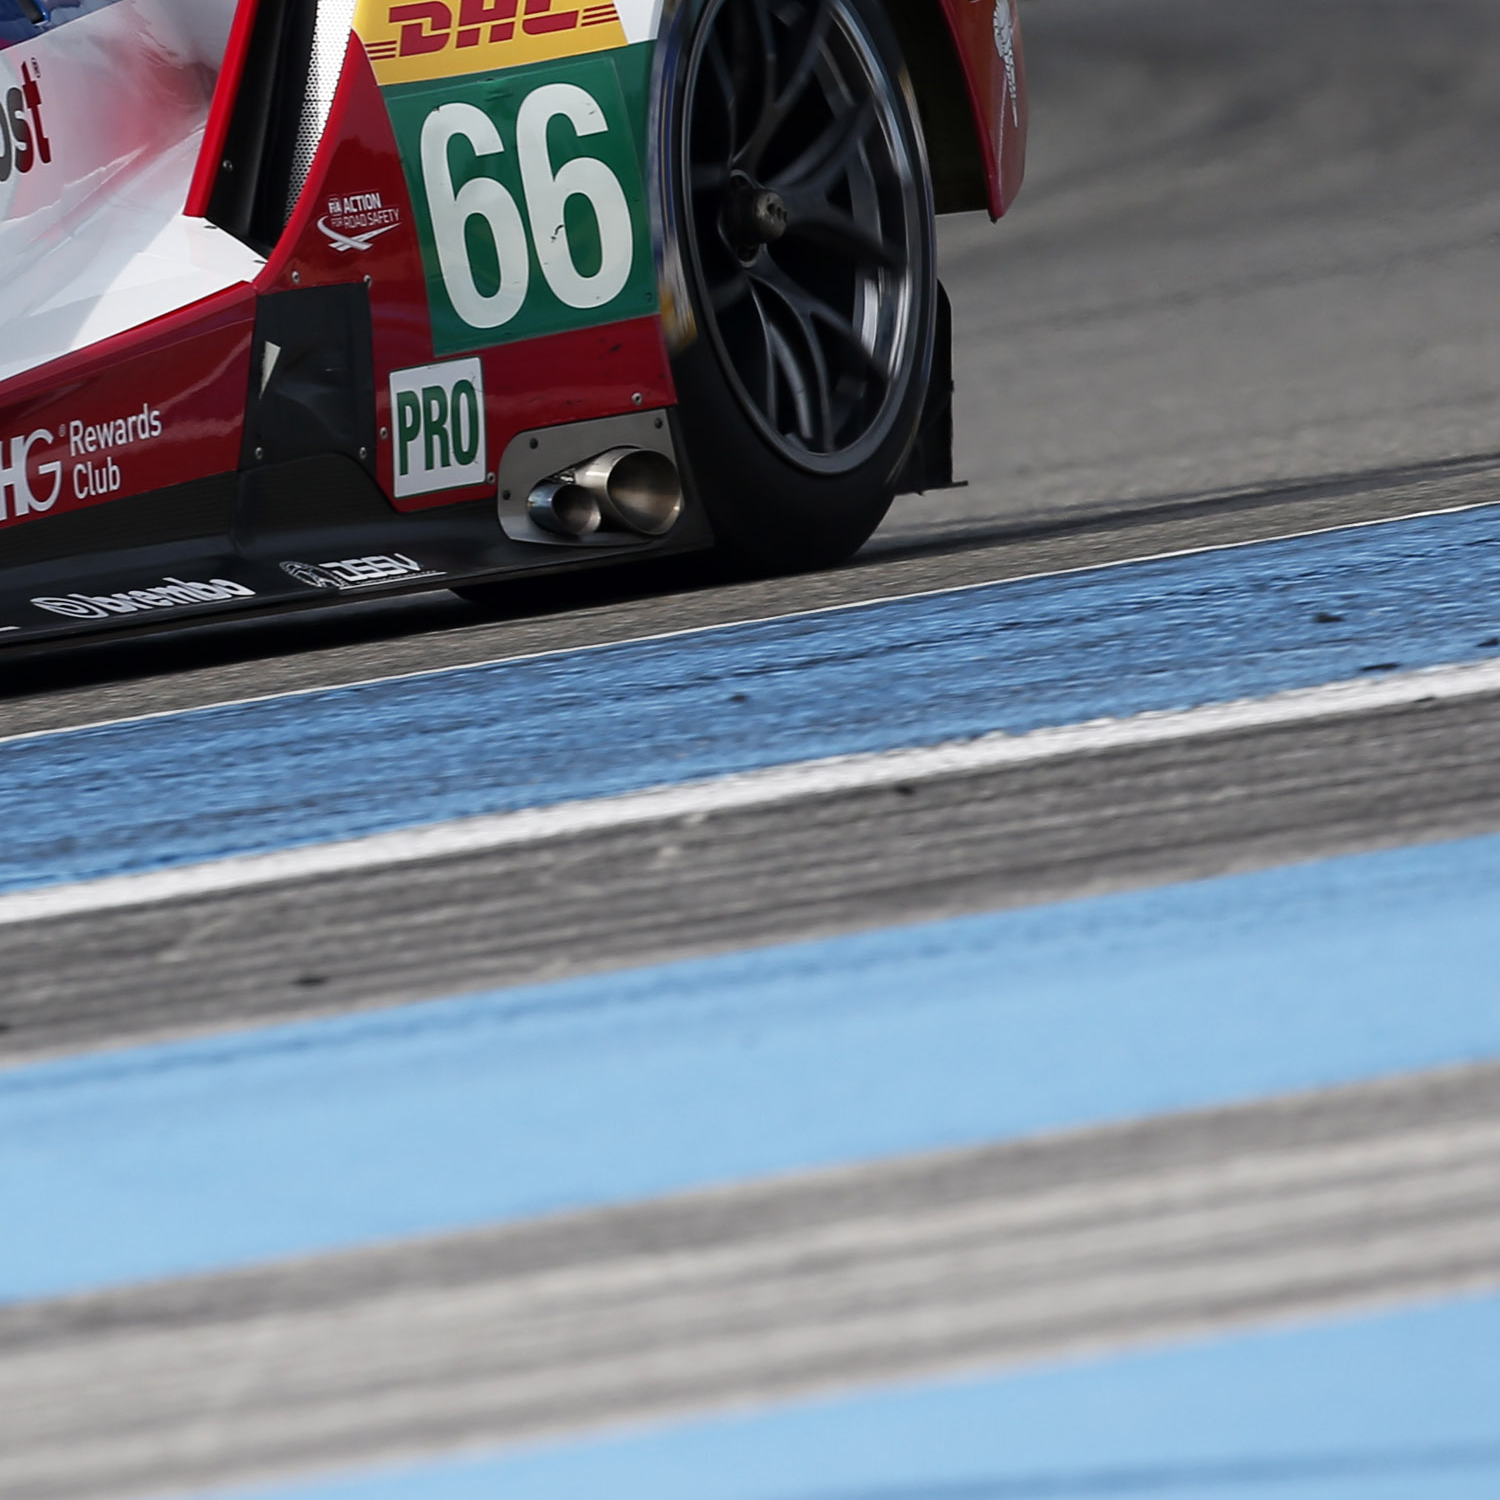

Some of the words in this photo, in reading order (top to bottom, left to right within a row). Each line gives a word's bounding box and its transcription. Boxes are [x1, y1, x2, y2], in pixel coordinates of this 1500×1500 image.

[343, 192, 382, 214] ACTION
[343, 213, 367, 229] ROAD
[367, 208, 400, 227] SAFETY
[419, 83, 633, 329] 66
[67, 403, 163, 456] Rewards
[397, 378, 479, 476] PRO
[72, 457, 122, 500] Club
[66, 576, 257, 613] brembo
